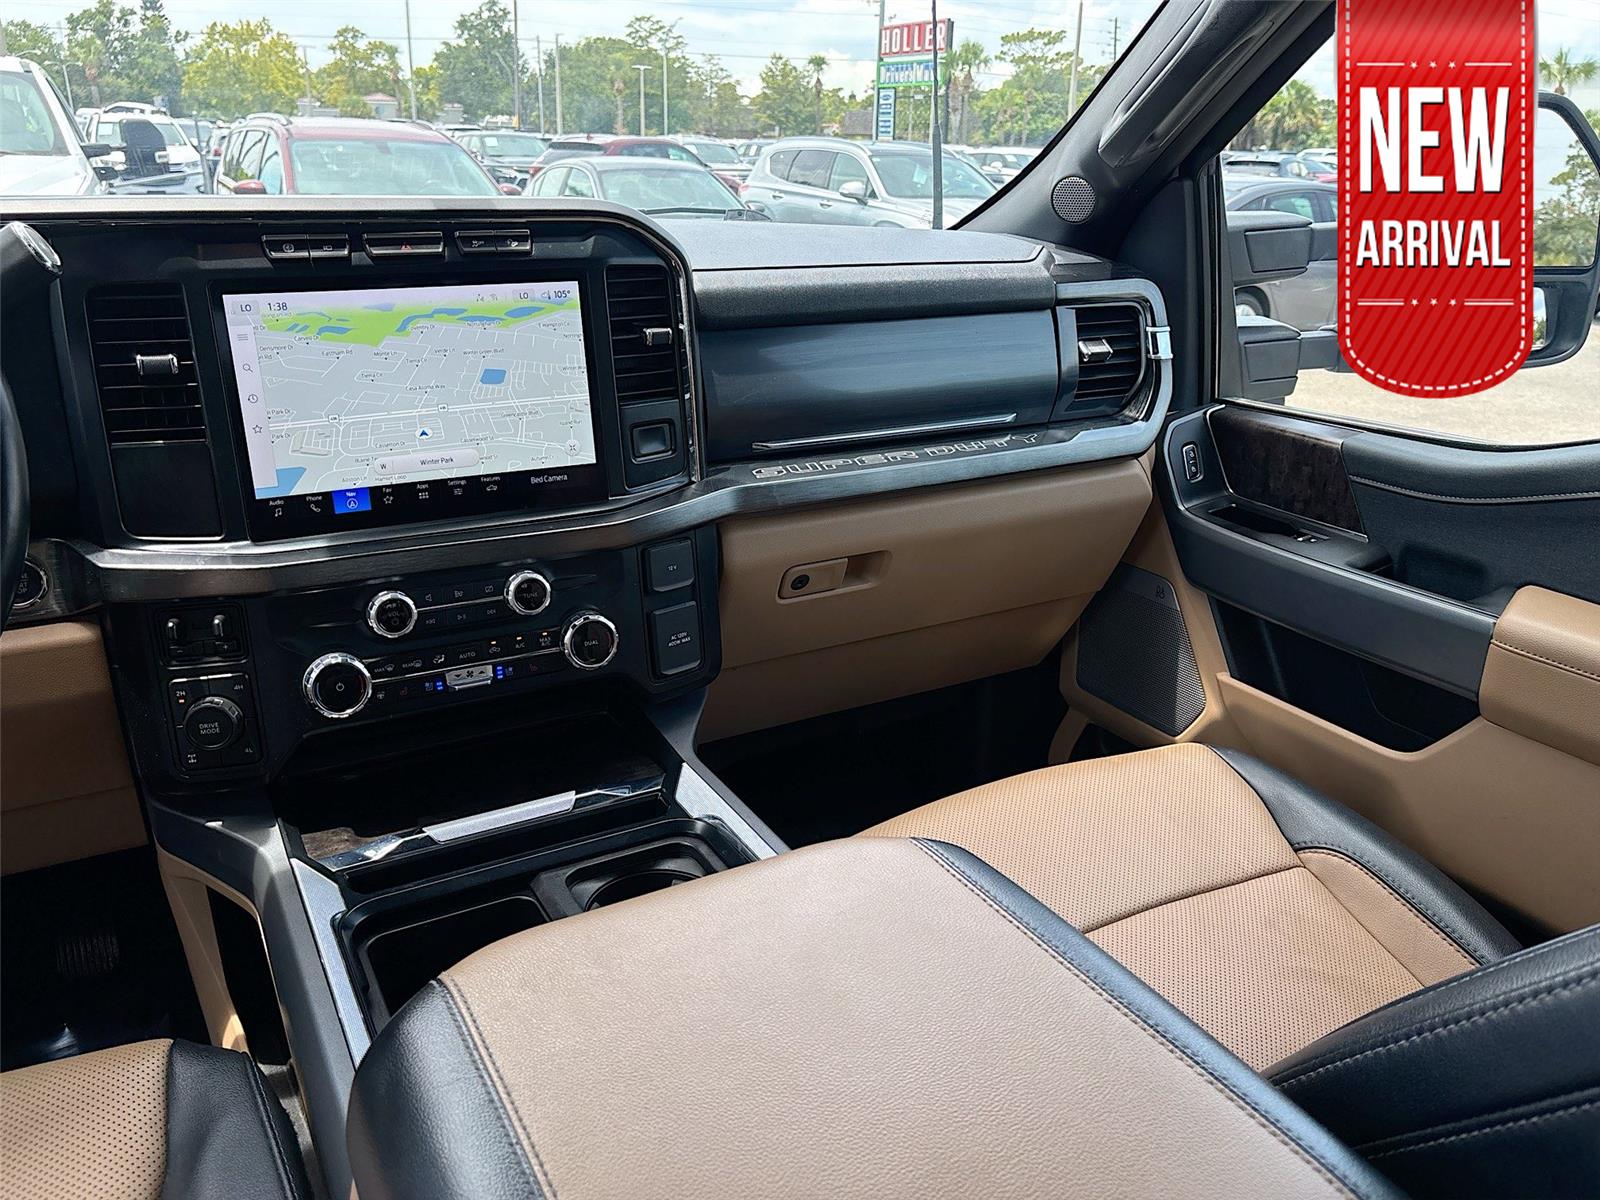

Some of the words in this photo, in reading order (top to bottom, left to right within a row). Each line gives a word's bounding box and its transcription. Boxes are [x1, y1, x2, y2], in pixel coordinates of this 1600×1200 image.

[881, 23, 946, 54] HOLLER
[240, 304, 252, 312] LO
[267, 302, 288, 312] 1:38
[419, 457, 439, 466] Winter
[439, 456, 454, 465] Park
[752, 450, 919, 479] SUPER
[530, 476, 543, 484] Bed
[543, 473, 568, 483] Camera
[306, 494, 322, 502] Phone
